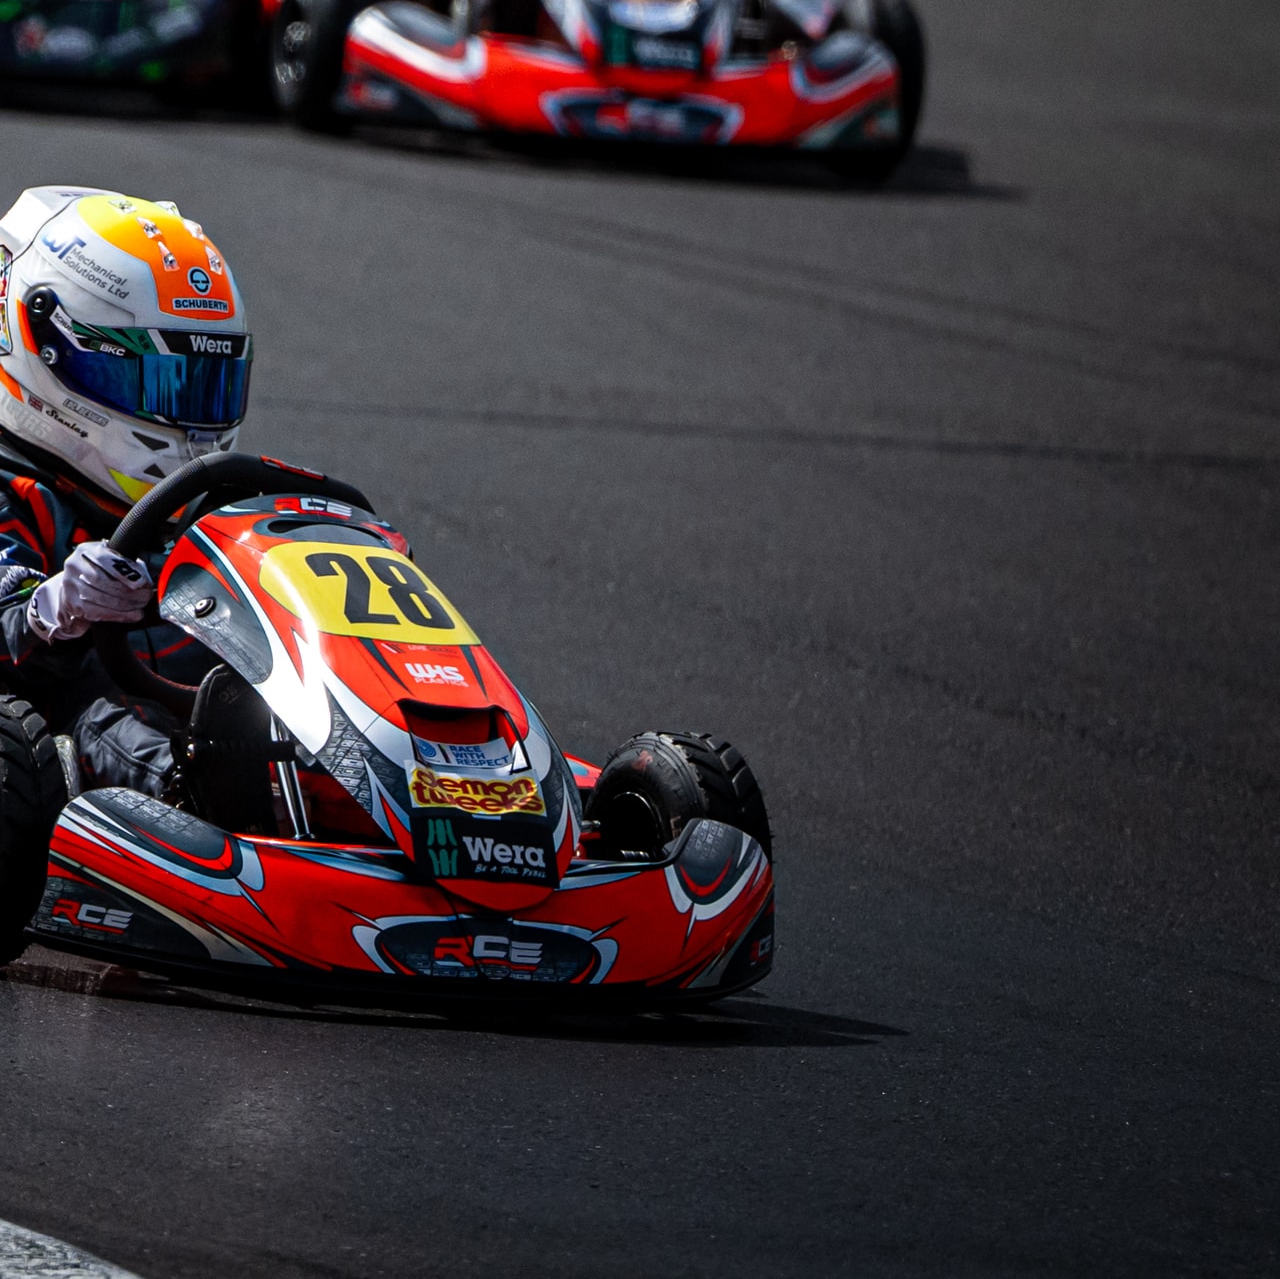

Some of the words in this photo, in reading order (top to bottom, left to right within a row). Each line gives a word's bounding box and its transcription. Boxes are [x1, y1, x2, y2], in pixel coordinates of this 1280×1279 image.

[63, 256, 108, 289] Solutions
[107, 284, 130, 300] Ltd
[70, 247, 128, 287] Mechanical
[174, 299, 228, 311] SCHUBERTH
[99, 344, 126, 357] BKC
[190, 335, 232, 354] Wera
[46, 408, 89, 438] Stanley
[305, 553, 455, 629] 28
[414, 677, 469, 687] PLASTICS
[448, 745, 482, 753] RACE
[452, 752, 486, 760] WITH
[455, 755, 509, 766] RESPECT
[415, 768, 536, 796] demon
[412, 781, 543, 812] tweeks
[462, 836, 546, 868] Wera
